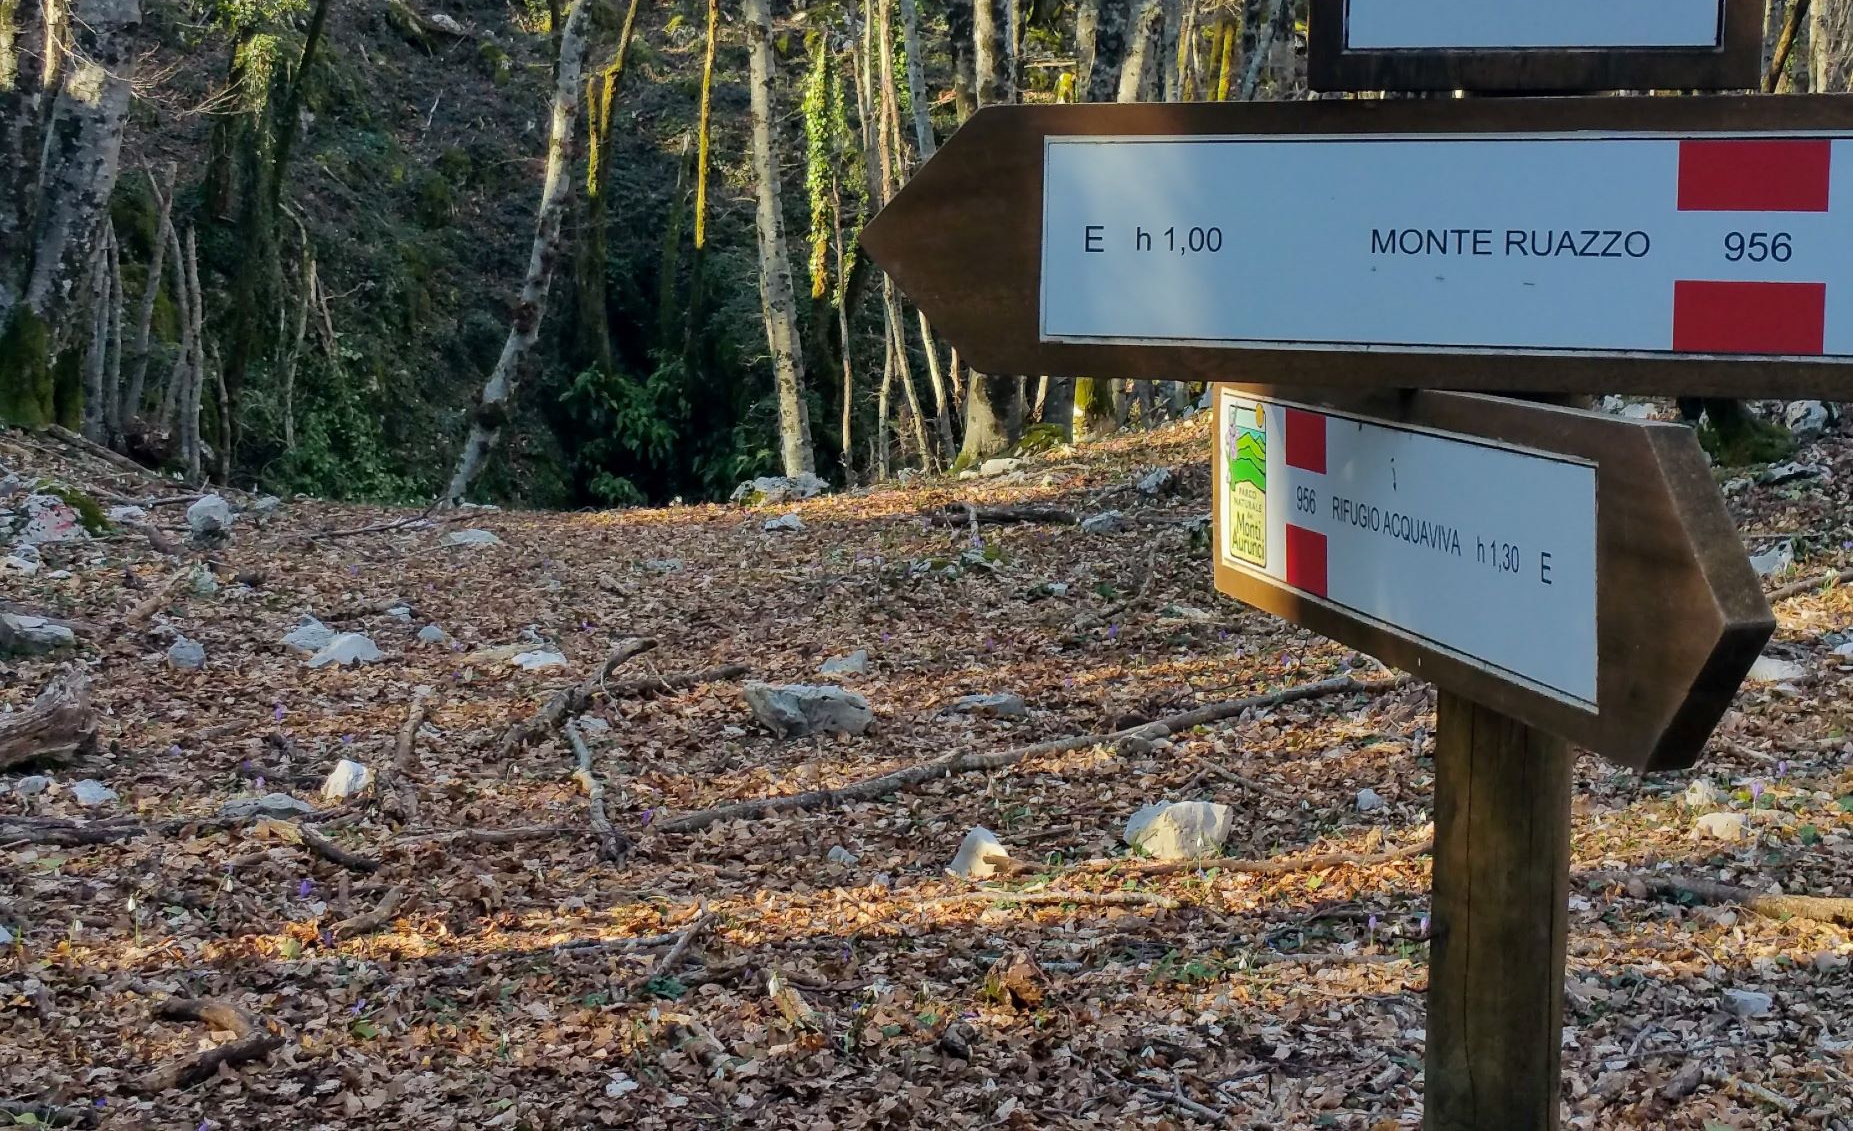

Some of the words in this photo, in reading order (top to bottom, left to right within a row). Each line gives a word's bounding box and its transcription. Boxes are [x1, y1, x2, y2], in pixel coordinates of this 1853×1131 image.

[1084, 225, 1105, 253] E
[1136, 226, 1152, 252] h
[1163, 226, 1223, 256] 1,00
[1370, 229, 1493, 256] MONTE
[1505, 230, 1651, 257] RUAZZO
[1723, 231, 1793, 262] 956
[1233, 497, 1262, 513] NATURALE
[1236, 511, 1261, 541] Monti
[1296, 486, 1316, 515] 956
[1332, 496, 1380, 532] RIFUGIO
[1383, 512, 1461, 556] ACQUAVIVA
[1541, 552, 1552, 584] E
[1232, 528, 1264, 560] Aurunci
